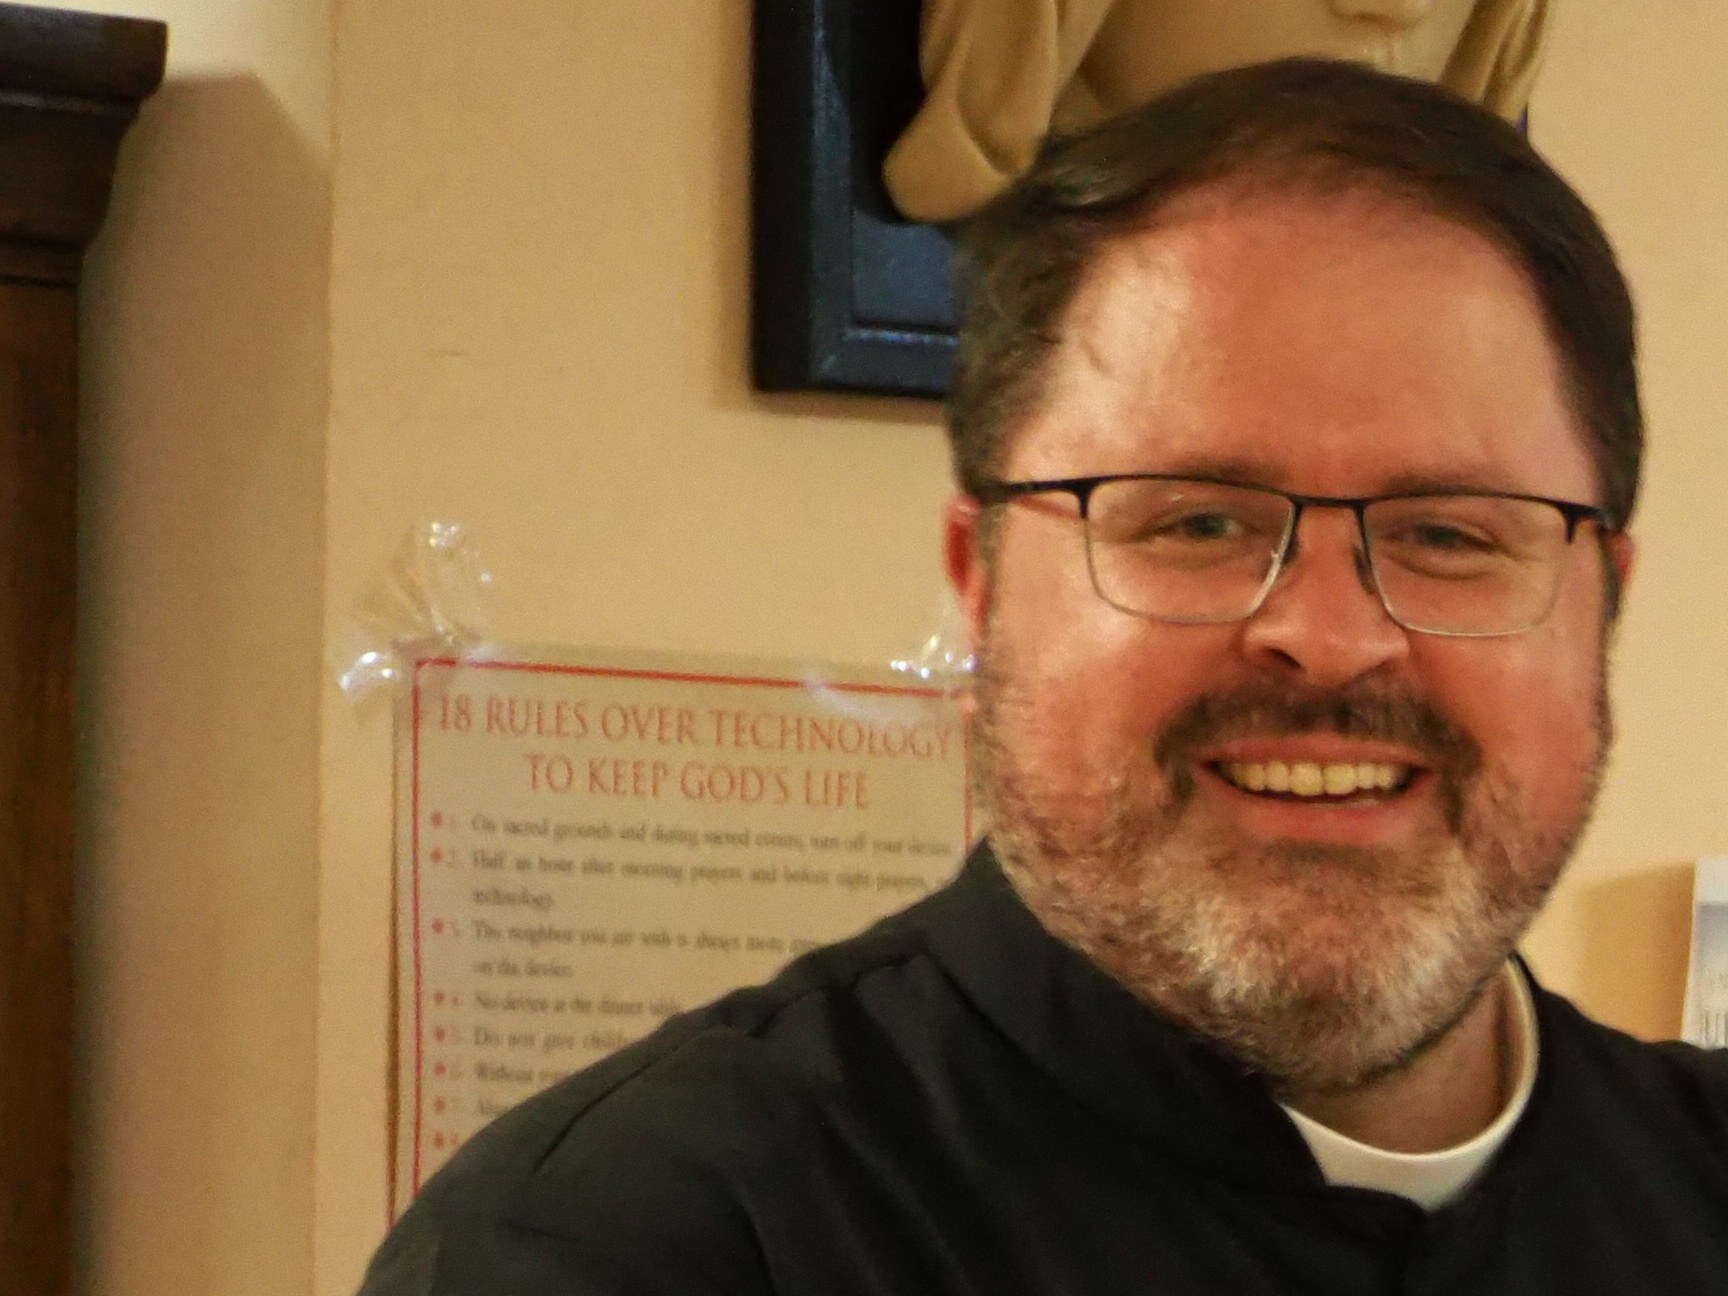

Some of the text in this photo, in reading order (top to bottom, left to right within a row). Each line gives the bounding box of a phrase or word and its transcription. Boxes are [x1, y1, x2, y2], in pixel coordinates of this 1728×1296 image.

[440, 693, 951, 761] 18 RULES OVER TECHNOLOGY
[523, 753, 868, 811] TO KEEP GOD'S LIFE
